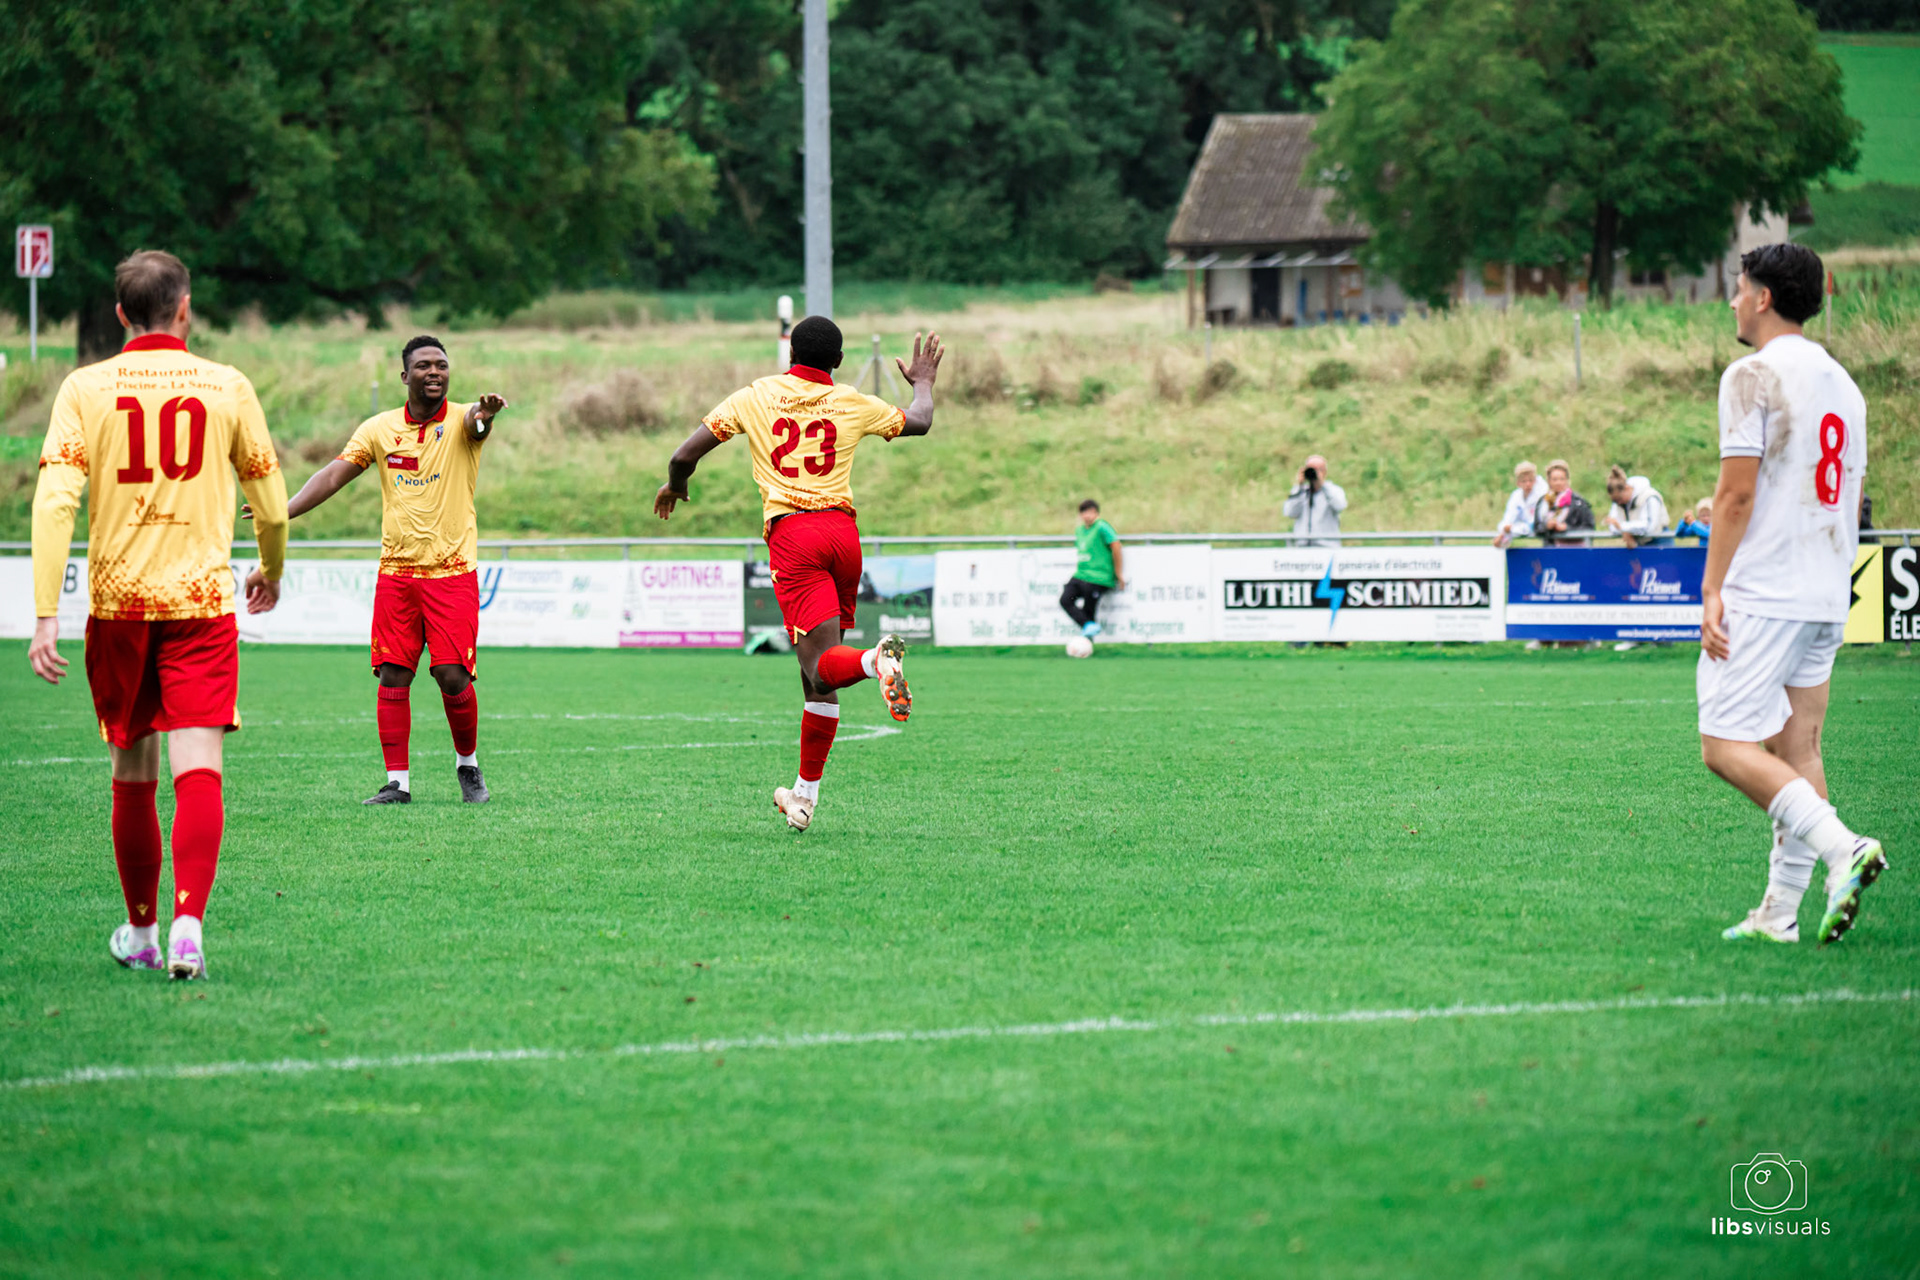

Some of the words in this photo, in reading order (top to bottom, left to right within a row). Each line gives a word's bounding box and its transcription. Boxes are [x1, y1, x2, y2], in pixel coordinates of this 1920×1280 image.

[118, 367, 198, 377] Restaurant
[116, 396, 207, 484] 10
[770, 416, 838, 479] 23
[1815, 413, 1848, 511] 8
[641, 565, 726, 589] GURTNER
[1226, 581, 1314, 608] LUTHI
[1346, 580, 1482, 607] SCHMIED
